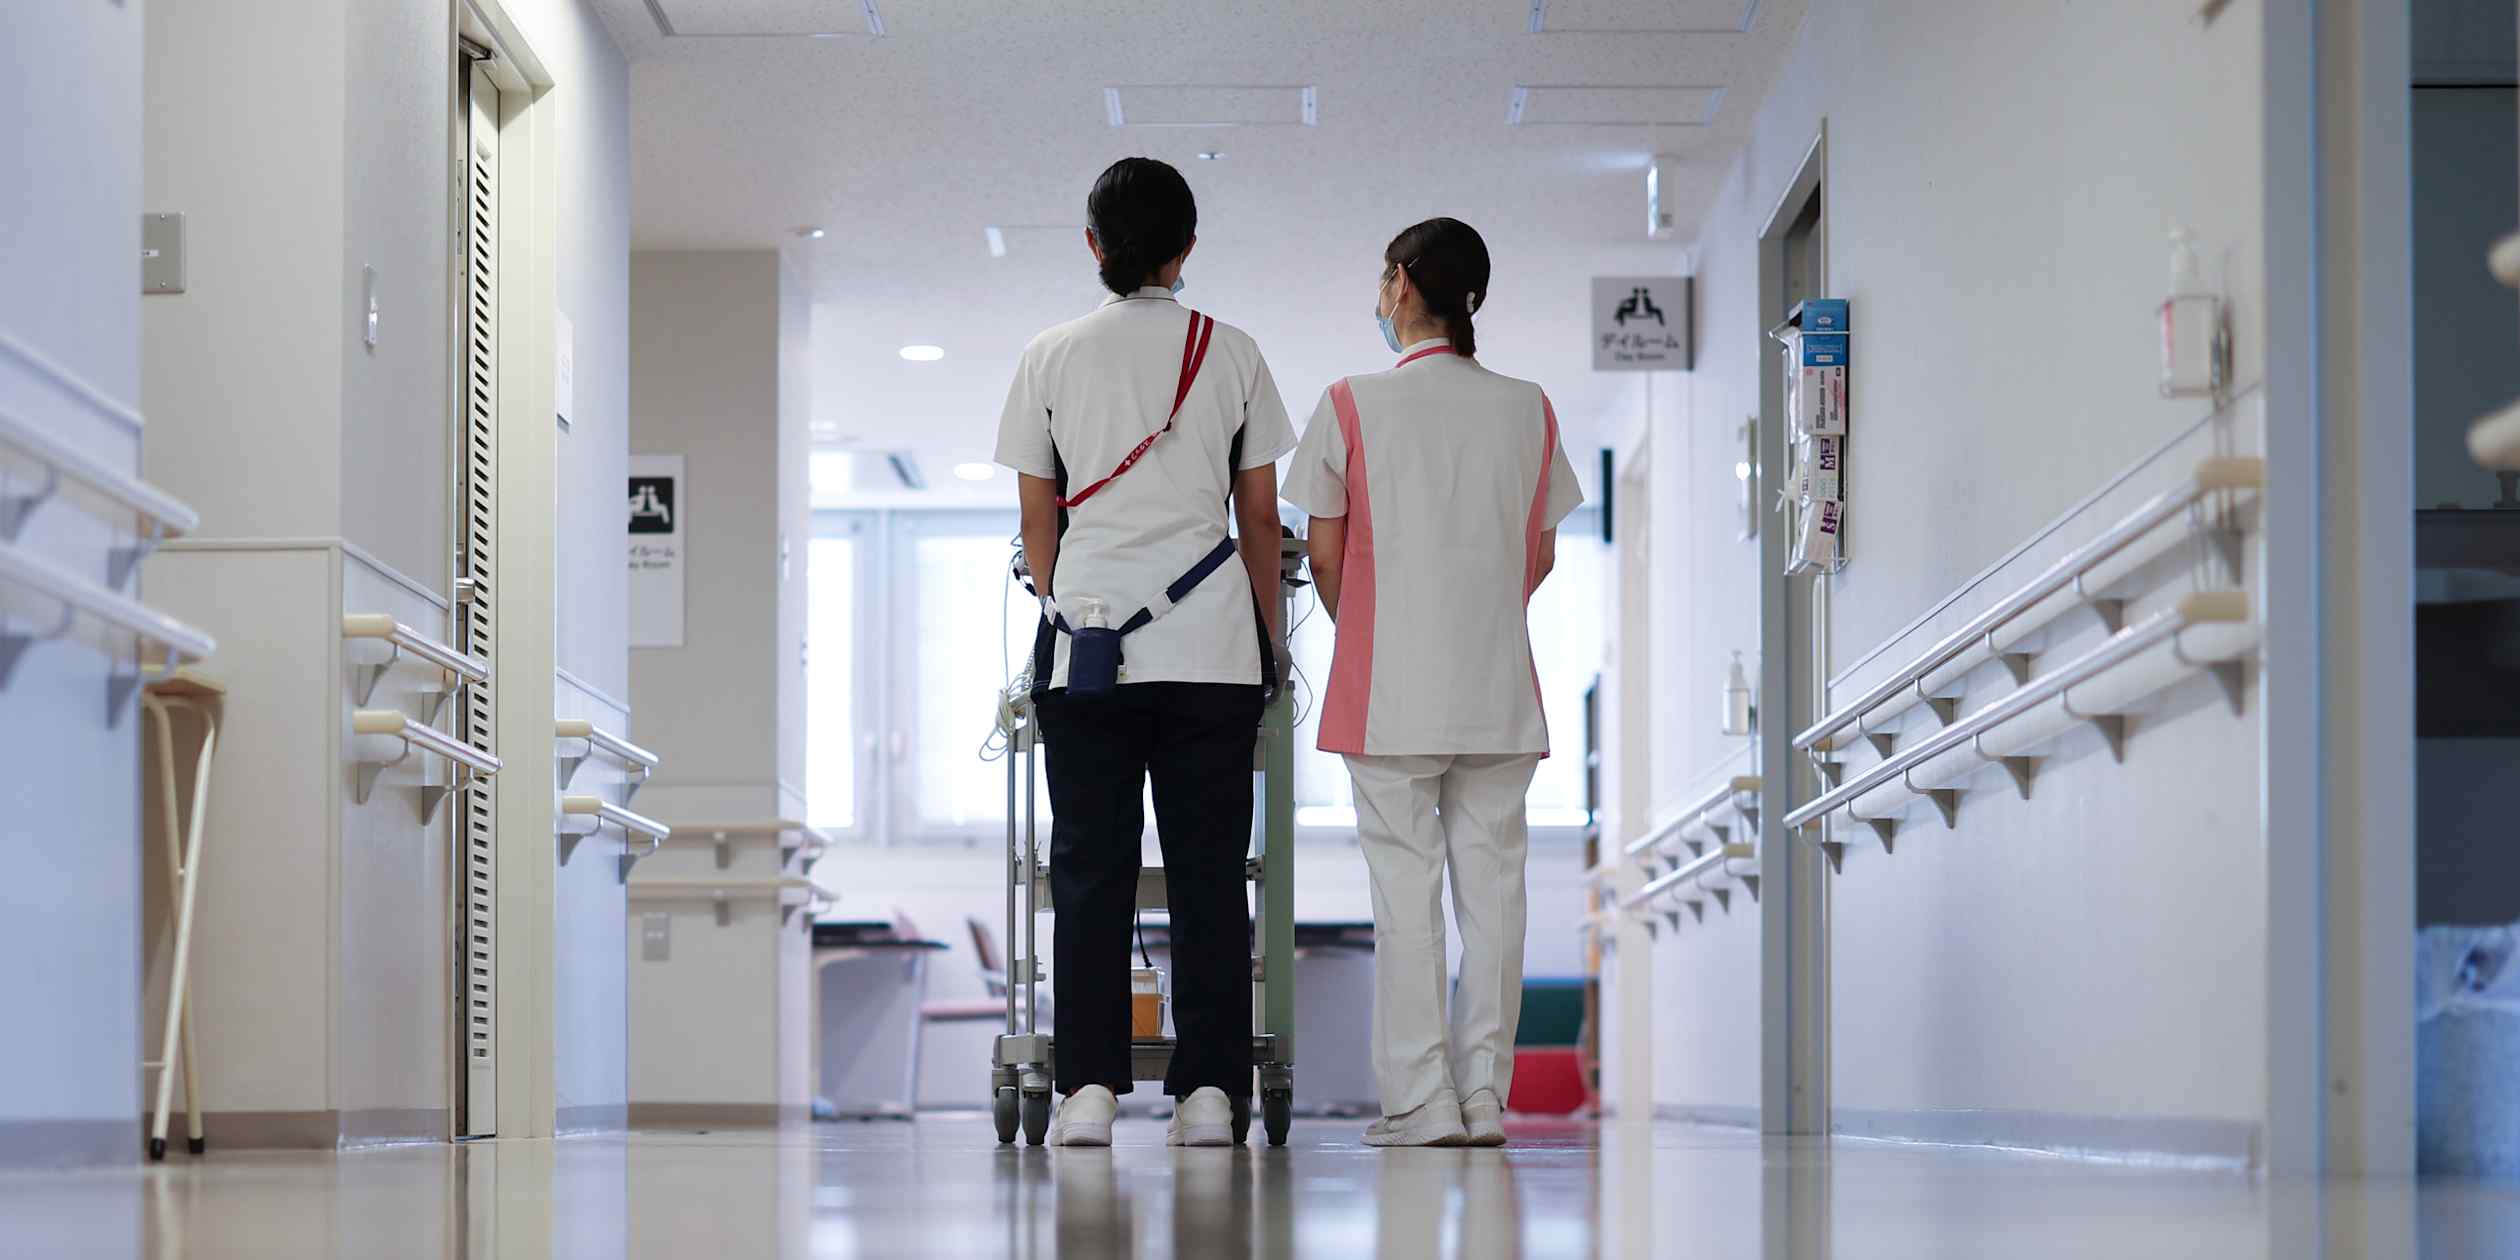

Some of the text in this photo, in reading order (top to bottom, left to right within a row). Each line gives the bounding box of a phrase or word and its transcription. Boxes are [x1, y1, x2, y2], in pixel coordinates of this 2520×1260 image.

[1601, 332, 1679, 350] デイルーム
[1615, 352, 1665, 363] Day Room
[628, 545, 675, 557] イルーム
